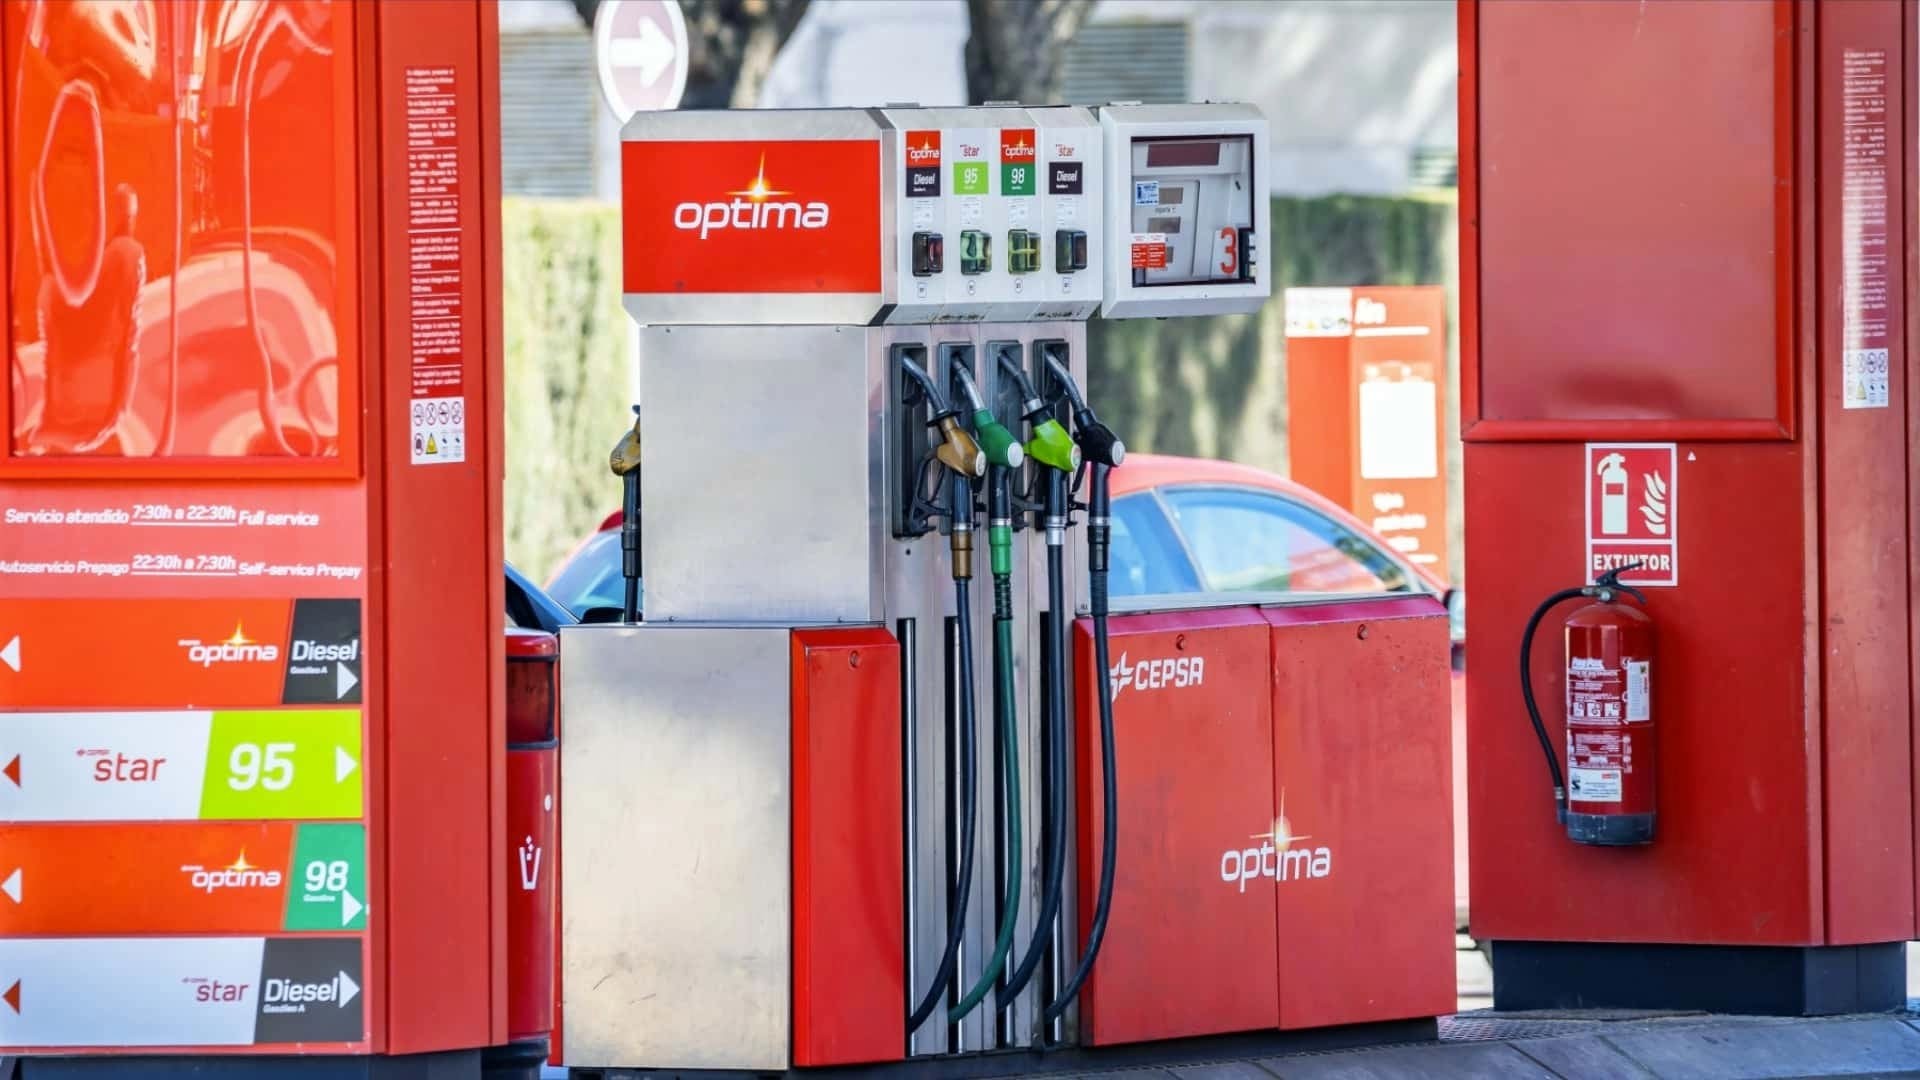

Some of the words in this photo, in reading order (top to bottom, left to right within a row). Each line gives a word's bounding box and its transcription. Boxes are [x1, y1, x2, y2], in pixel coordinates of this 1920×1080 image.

[911, 149, 940, 163] optima
[1006, 146, 1034, 159] optima
[914, 173, 936, 185] Diesel
[964, 167, 978, 184] 95
[1011, 167, 1025, 184] 98
[1056, 170, 1078, 183] Diesel
[674, 197, 829, 239] optima
[1220, 226, 1237, 275] 3
[5, 508, 63, 524] Servicio
[66, 509, 129, 525] atendido
[132, 505, 171, 520] 7:30h
[174, 508, 184, 520] a
[187, 505, 236, 521] 22:30h
[238, 510, 265, 525] Full
[266, 511, 320, 527] service
[77, 560, 129, 577] Prepago
[132, 554, 182, 570] 22:30h
[185, 558, 195, 570] a
[196, 554, 236, 570] 7:30h
[238, 562, 315, 577] Self-service
[317, 563, 362, 580] Prepay
[1593, 553, 1670, 571] EXTINTOR
[189, 643, 278, 668] optima
[292, 638, 359, 661] Diesel
[1135, 656, 1204, 691] CEPSA
[94, 752, 166, 782] star
[227, 742, 296, 791] 95
[305, 860, 349, 892] 98
[1221, 841, 1331, 893] optima
[191, 868, 282, 894] optima
[196, 980, 248, 1003] star
[264, 977, 339, 1003] Diesel
